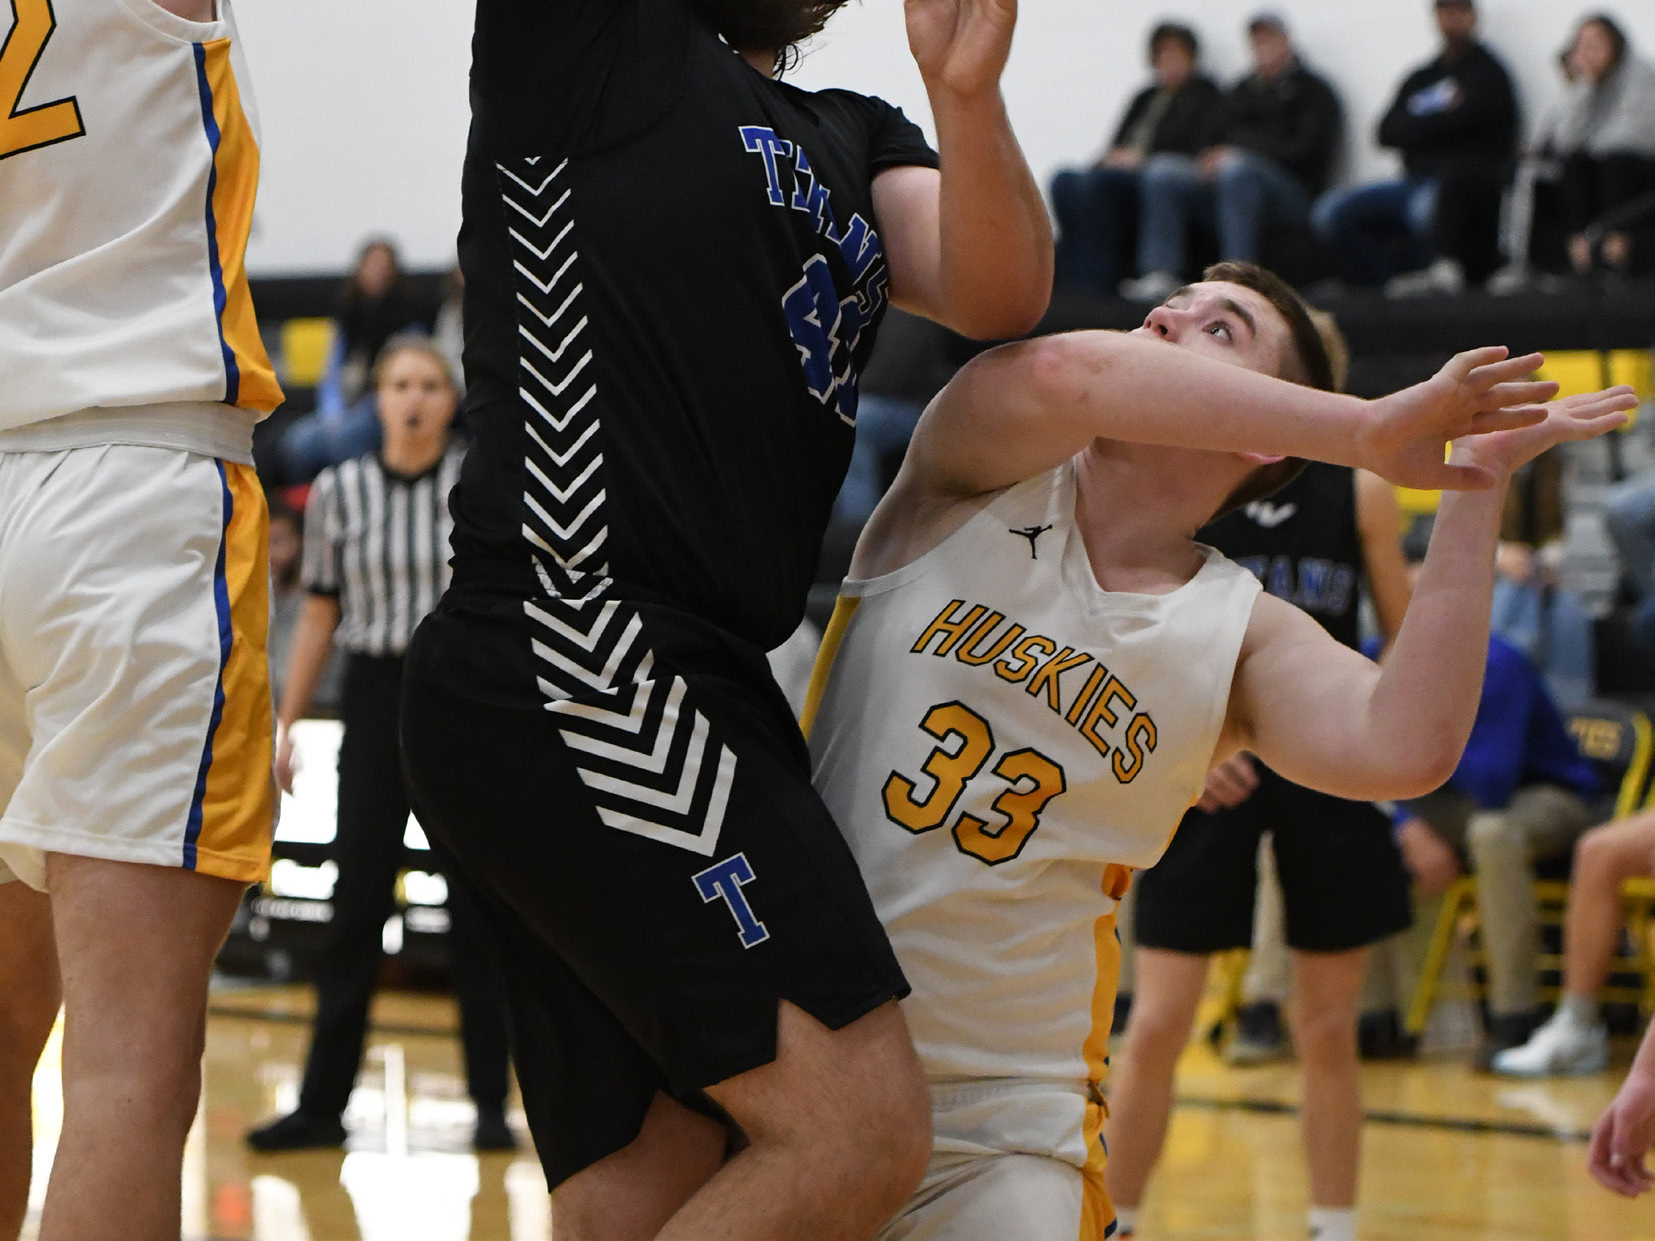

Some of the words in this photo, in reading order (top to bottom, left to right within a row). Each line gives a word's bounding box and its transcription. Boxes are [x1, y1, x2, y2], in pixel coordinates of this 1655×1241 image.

[910, 599, 1157, 784] HUSKIES
[881, 700, 1067, 866] 33
[691, 852, 770, 949] T
